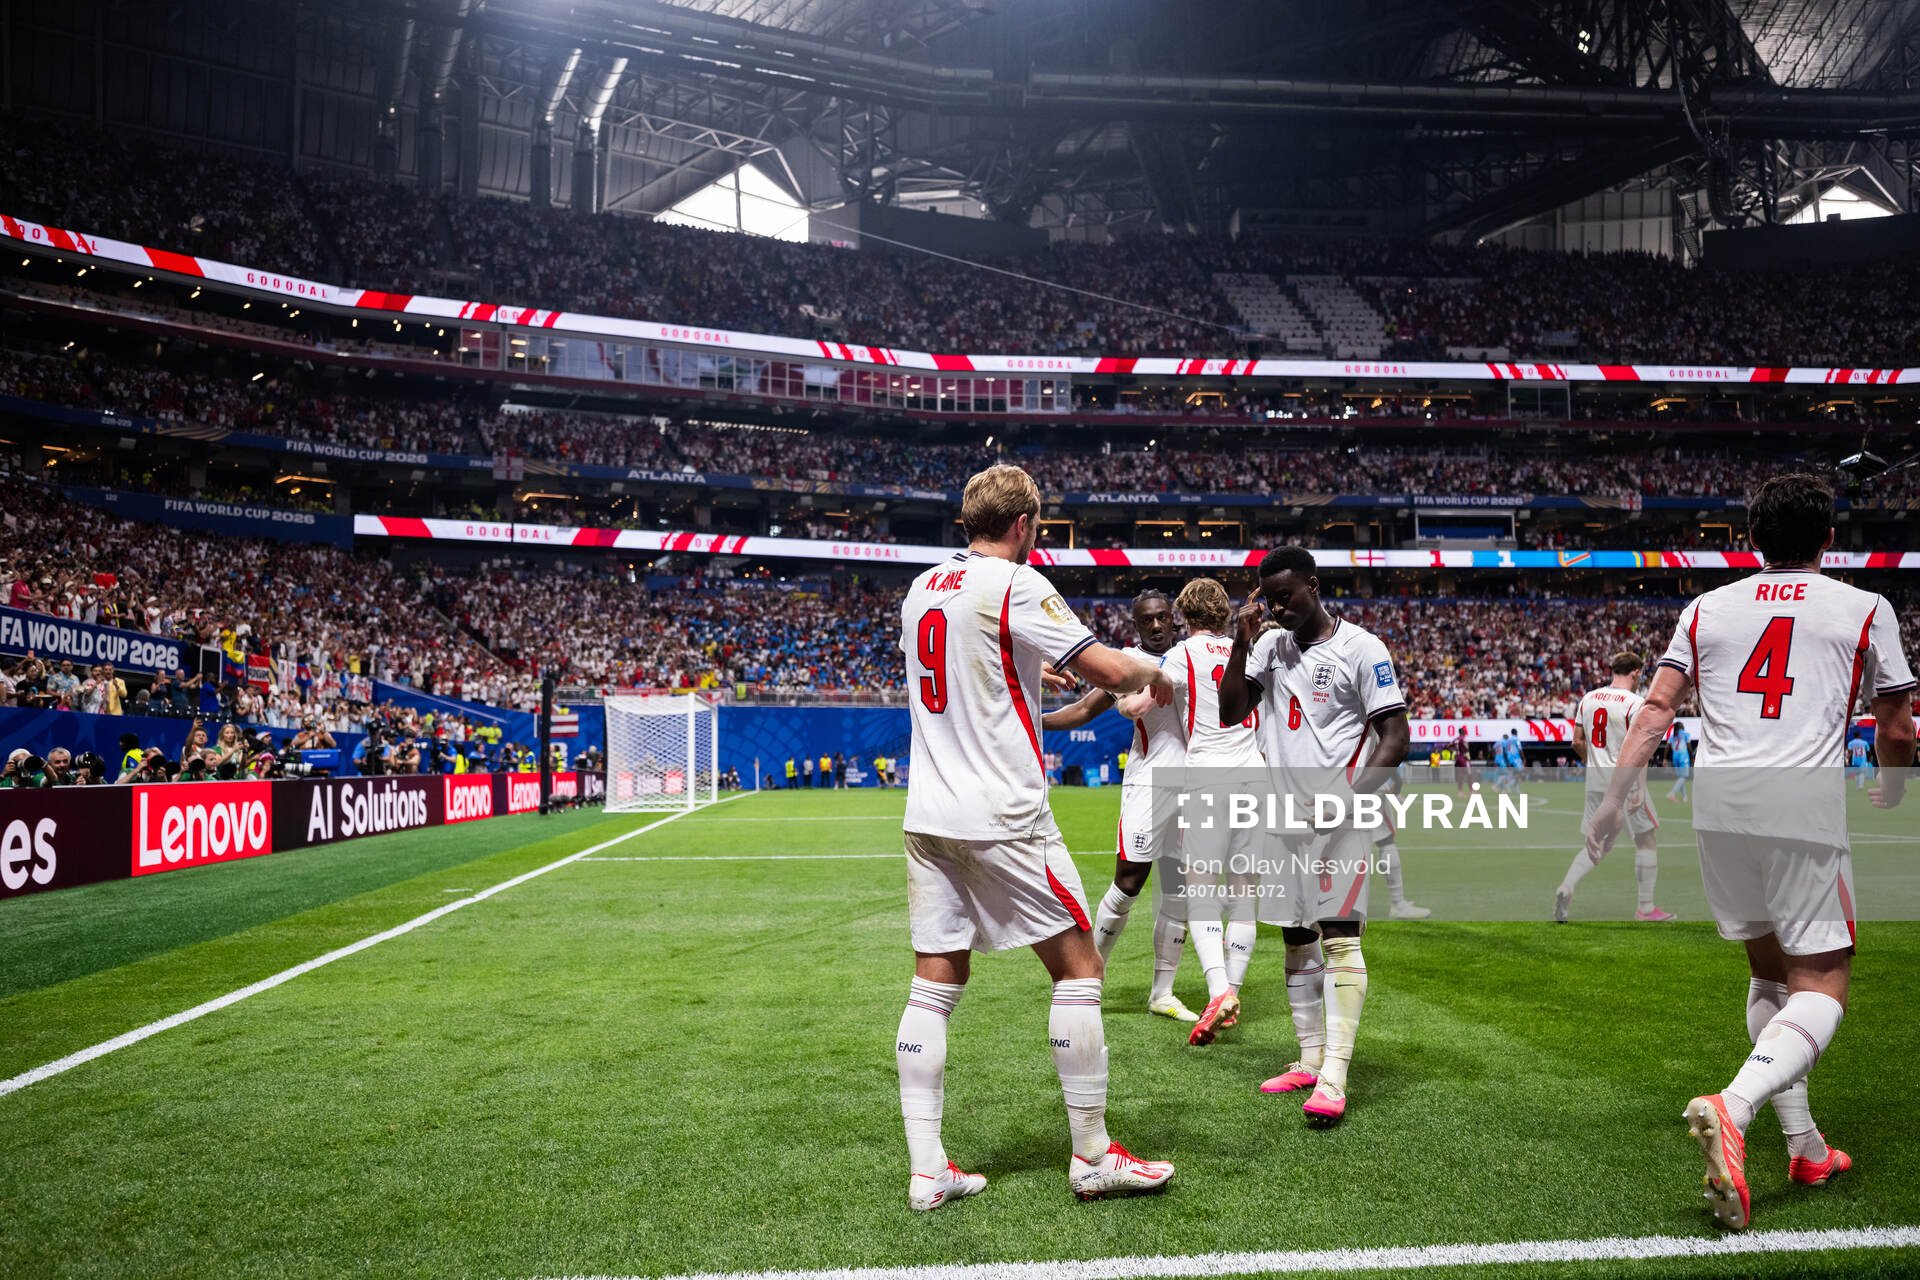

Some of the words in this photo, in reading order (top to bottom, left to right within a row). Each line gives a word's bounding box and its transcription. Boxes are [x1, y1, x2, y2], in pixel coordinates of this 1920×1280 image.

[247, 272, 327, 298] GOOOOAL
[661, 327, 728, 344] GOOOOAL
[1007, 360, 1071, 369] GOOOOAL
[1345, 365, 1406, 374] GOOOOAL
[1669, 366, 1728, 378] GOOOOAL
[286, 440, 312, 453] FIFA
[314, 445, 357, 460] WORLD
[358, 451, 383, 461] CUP
[385, 452, 428, 464] 2026
[627, 469, 706, 484] ATLANTA
[1087, 493, 1160, 503] ATLANTA
[1414, 496, 1434, 505] FIFA
[1436, 496, 1468, 506] WORLD
[1470, 496, 1490, 506] CUP
[1491, 497, 1524, 506] 2026
[165, 499, 193, 513] FIFA
[195, 502, 243, 517] WORLD
[245, 507, 270, 519] CUP
[271, 510, 316, 525] 2026
[466, 525, 549, 540] GOOOOAL
[833, 545, 900, 559] GOOOOAL
[1158, 553, 1226, 563] GOOOOAL
[1430, 550, 1445, 567] 1
[1498, 550, 1515, 567] 1
[926, 570, 966, 592] KANE
[1755, 583, 1808, 601] RICE
[27, 621, 93, 657] WORLD
[97, 633, 129, 663] CUP
[129, 640, 179, 671] 2026
[917, 608, 948, 714] 9
[1736, 616, 1795, 719] 4
[1288, 695, 1301, 730] 6
[1070, 730, 1096, 742] FIFA
[1592, 707, 1608, 749] 8
[445, 778, 491, 820] Lenovo
[507, 775, 541, 812] Lenovo
[307, 785, 333, 842] AI
[340, 779, 428, 837] Solutions
[139, 792, 267, 867] Lenovo
[1, 817, 57, 890] es
[1231, 942, 1247, 951] ENG
[898, 1042, 922, 1054] ENG
[1050, 1038, 1071, 1048] ENG
